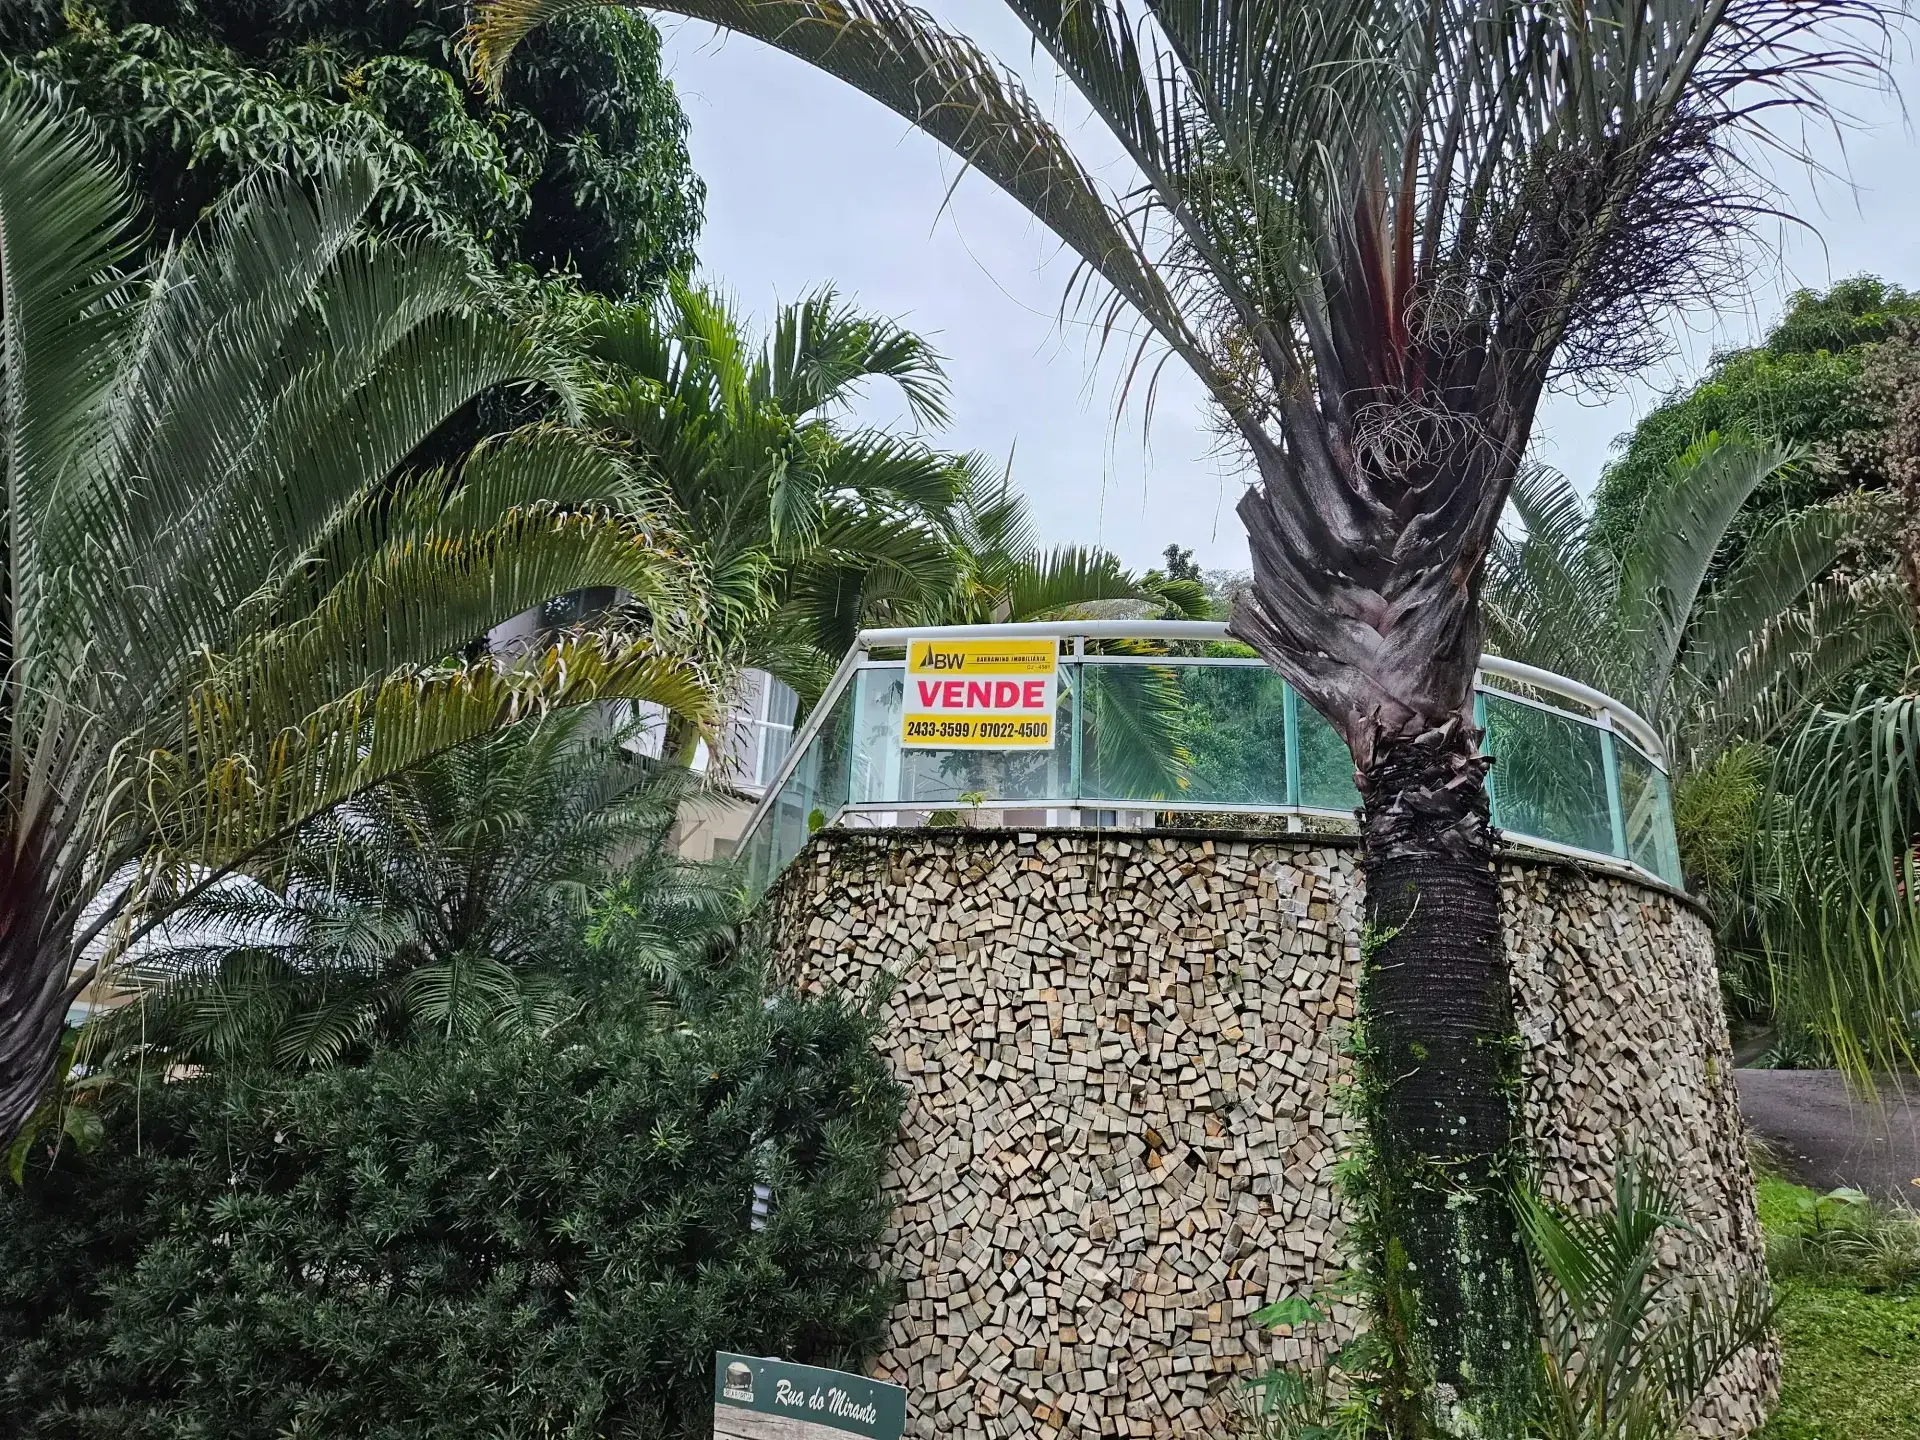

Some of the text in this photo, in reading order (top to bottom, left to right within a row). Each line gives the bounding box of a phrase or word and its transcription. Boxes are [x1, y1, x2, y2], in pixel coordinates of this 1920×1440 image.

[917, 680, 1046, 708] VENDE
[907, 721, 1048, 738] 2433-3599 / 97022-4500
[775, 1379, 805, 1407] Rua
[808, 1387, 825, 1410] do
[828, 1387, 877, 1425] Mirante
